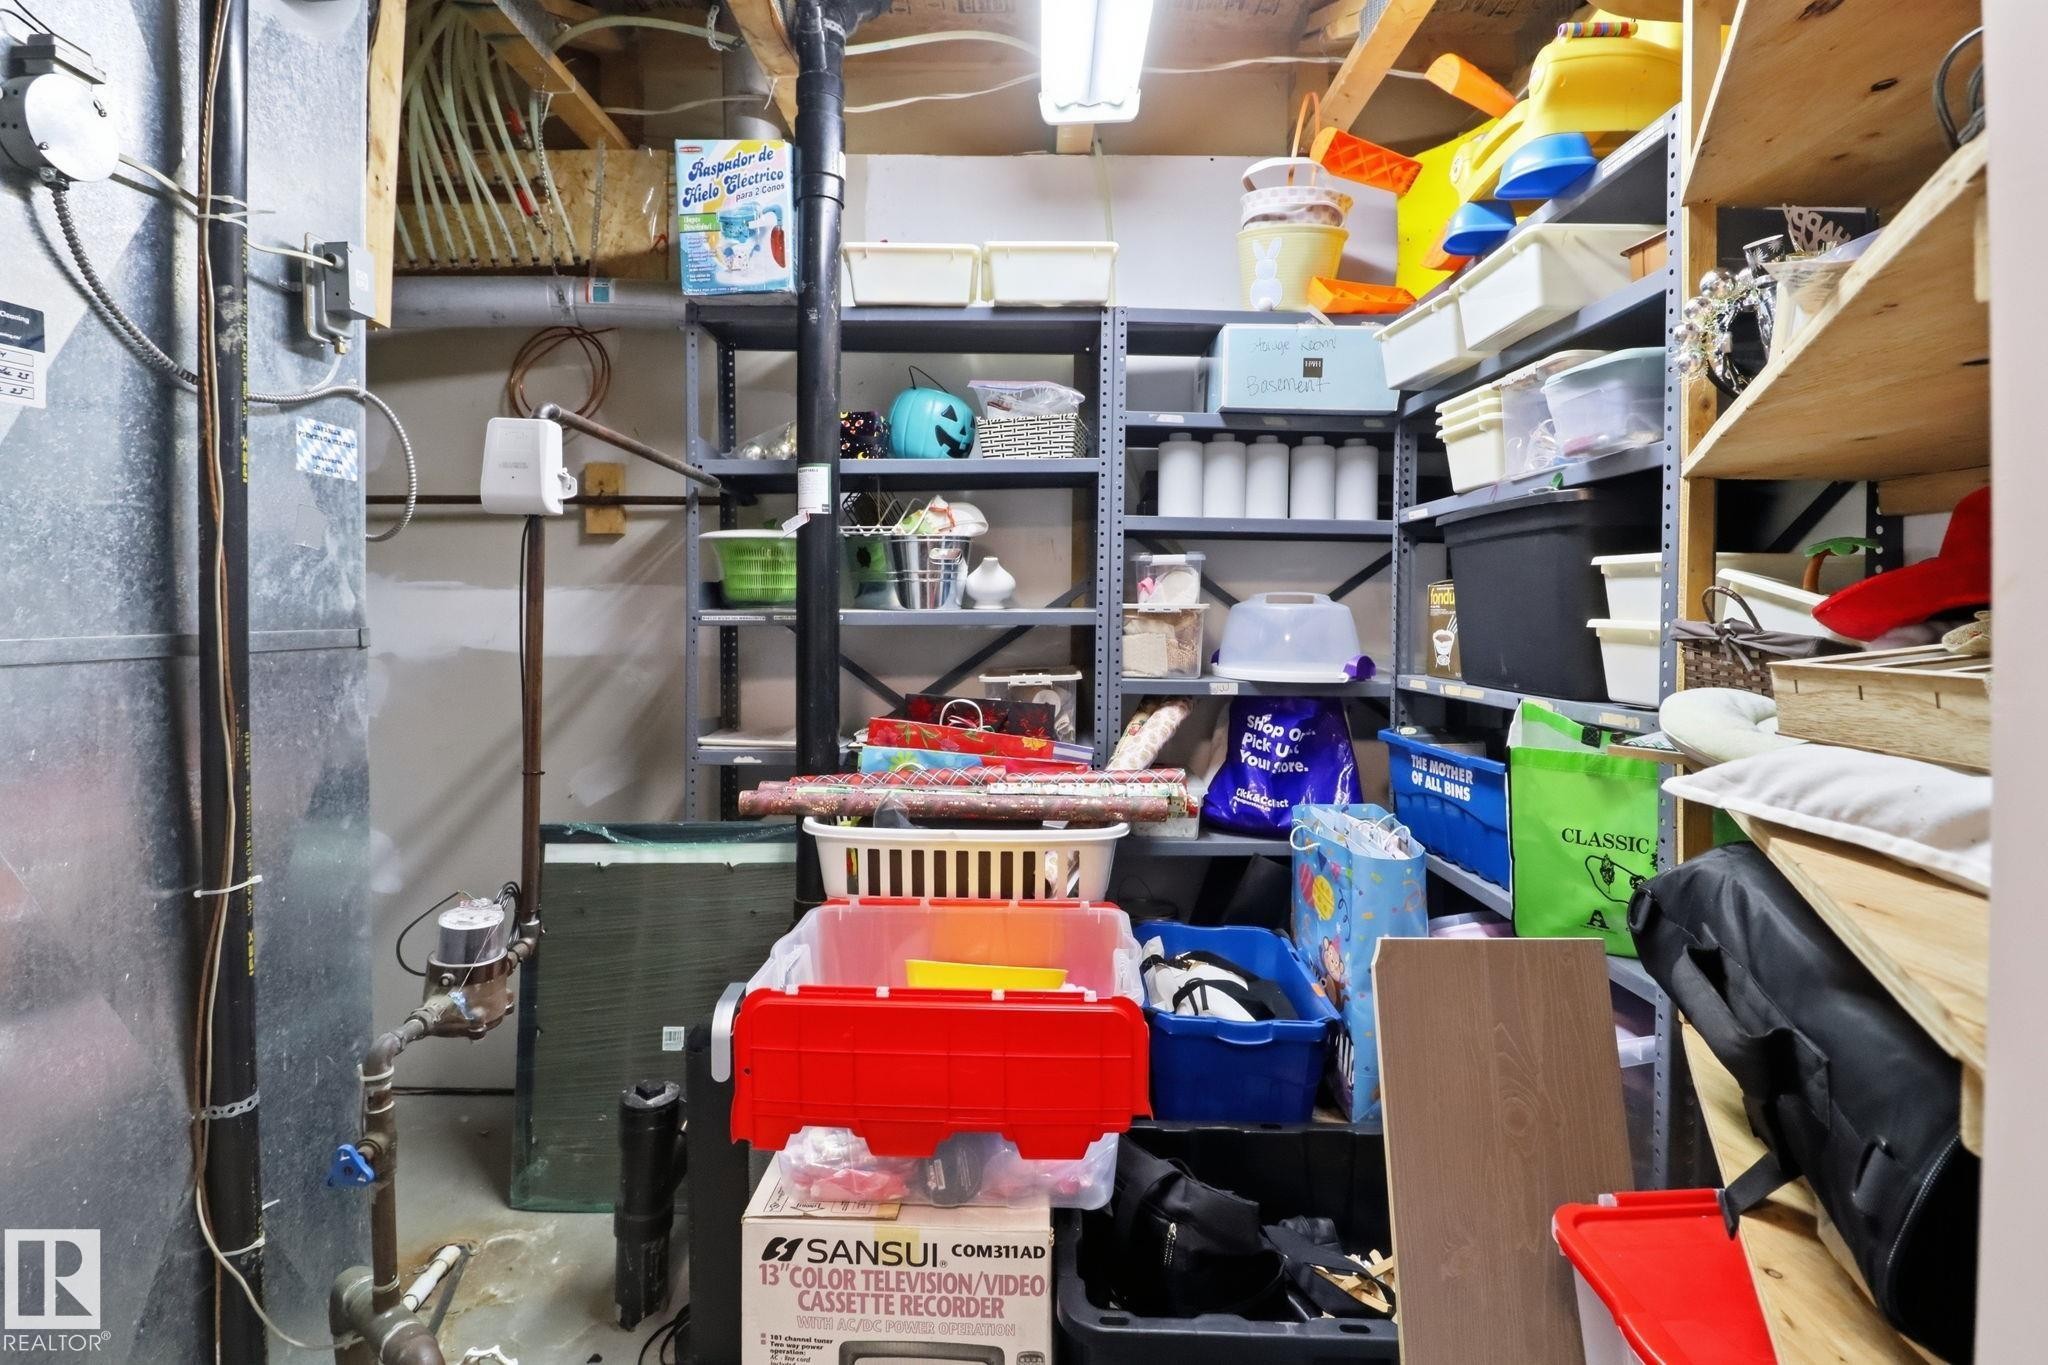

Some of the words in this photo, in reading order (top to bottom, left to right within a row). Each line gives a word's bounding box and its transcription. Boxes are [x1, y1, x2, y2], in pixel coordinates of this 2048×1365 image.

[688, 152, 755, 181] Raspador
[758, 145, 774, 162] de
[682, 183, 719, 208] Hielo
[735, 191, 753, 202] para
[755, 187, 761, 196] 2
[761, 184, 785, 194] Conos
[1246, 375, 1331, 397] Basement
[1246, 714, 1285, 739] Shop
[1241, 732, 1271, 753] Pick
[1411, 754, 1428, 771] THE
[1429, 759, 1474, 785] MOTHER
[1411, 770, 1423, 786] OF
[1424, 774, 1443, 793] ALL
[1444, 780, 1471, 802] BINS
[1561, 827, 1650, 854] CLASSIC
[951, 1243, 1046, 1259] COM311AD
[797, 1290, 896, 1316] CASSETTE
[900, 1295, 1005, 1319] RECORDER
[784, 1335, 812, 1343] channel
[797, 1316, 834, 1331] WITH
[836, 1317, 882, 1333] AC/DC
[885, 1319, 935, 1335] POWER
[938, 1321, 1016, 1337] OPERATION
